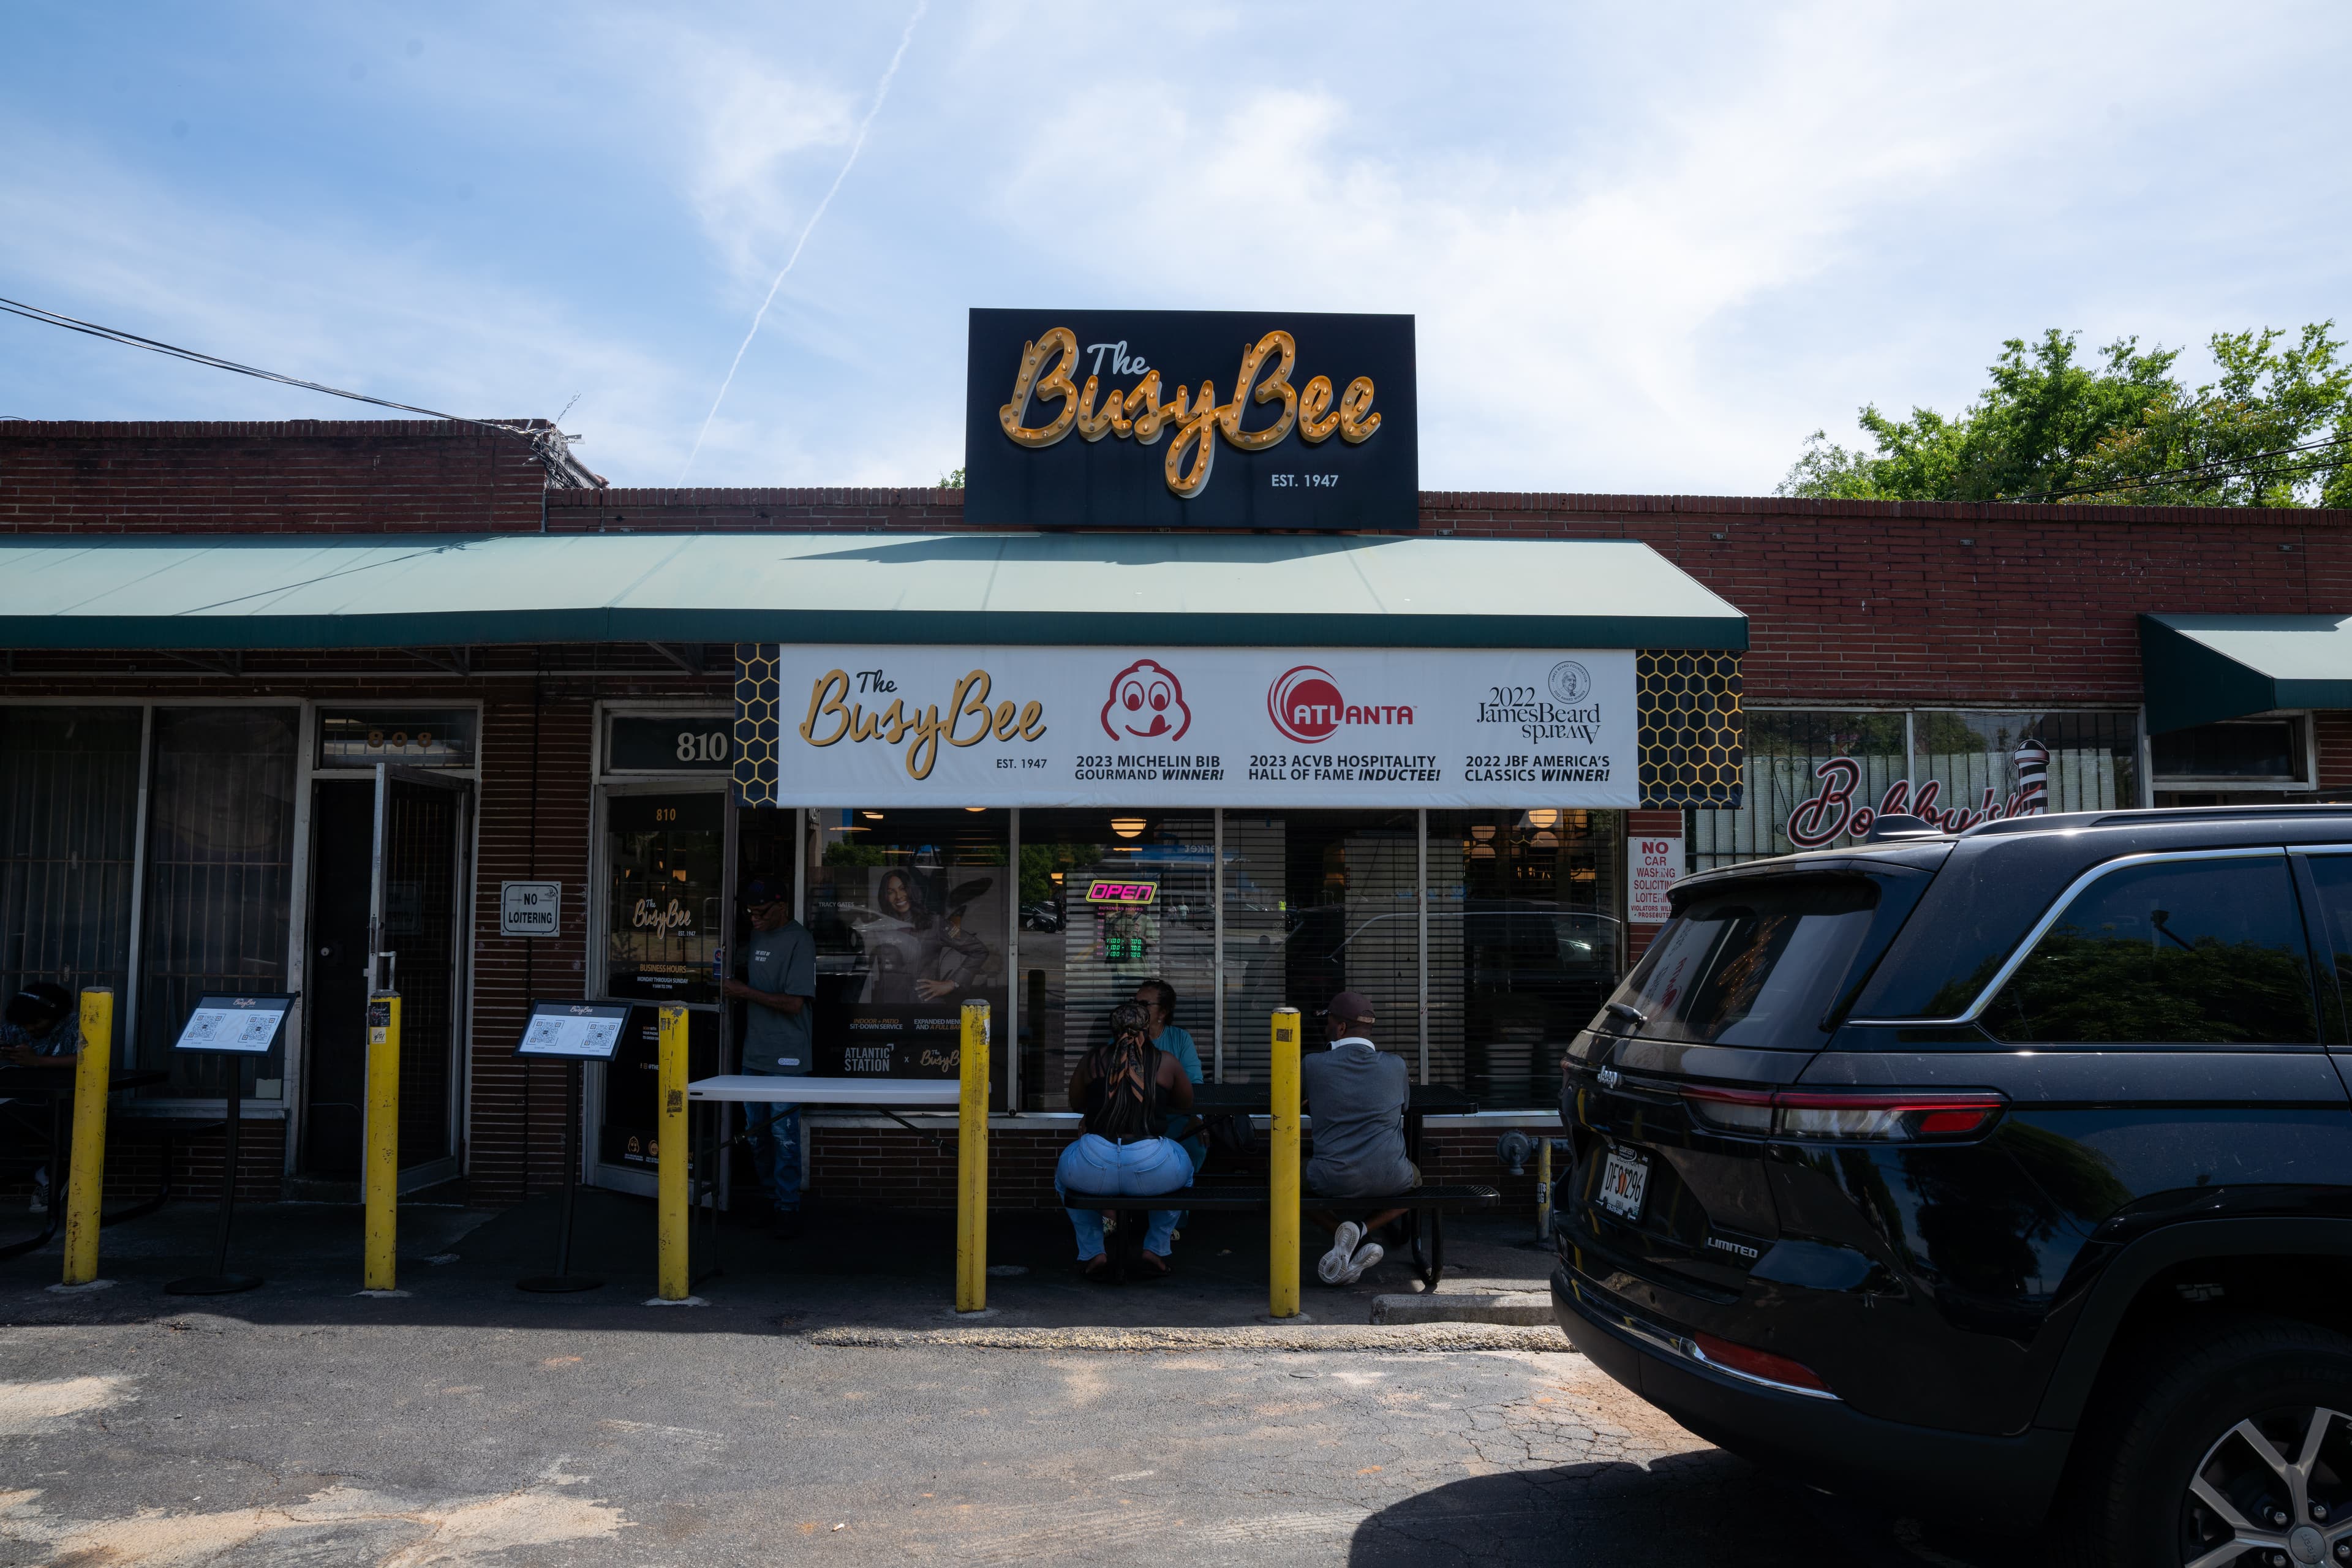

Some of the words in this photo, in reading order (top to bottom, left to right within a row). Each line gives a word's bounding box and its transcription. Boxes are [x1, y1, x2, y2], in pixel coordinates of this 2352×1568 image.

[1087, 341, 1150, 375] The
[999, 326, 1220, 499] Busy
[1219, 330, 1382, 450] Bee
[1272, 475, 1298, 487] EST.
[1304, 475, 1339, 487] 1947
[856, 669, 897, 693] The
[1488, 687, 1536, 707] 2022
[1294, 704, 1413, 725] ATLANTA
[799, 669, 940, 780] Busy
[940, 669, 1047, 748] Bee
[368, 730, 432, 748] 808
[1521, 724, 1601, 745] Awards
[676, 732, 728, 762] 810
[997, 758, 1017, 769] EST.
[1021, 758, 1047, 769] 1947
[1076, 755, 1112, 767] 2023
[1117, 755, 1191, 767] MICHELIN
[1196, 755, 1220, 767] BIB
[1250, 755, 1287, 767] 2023
[1292, 755, 1333, 767] ACVB
[1337, 755, 1436, 767] HOSPITALITY
[1466, 755, 1500, 767] 2022
[1504, 755, 1529, 767] JBF
[1533, 755, 1610, 767] AMERICA'S
[1074, 769, 1157, 780] GOURMAND
[1163, 769, 1224, 781] WINNER!
[1248, 769, 1286, 780] HALL
[1291, 769, 1310, 780] OF
[1314, 769, 1354, 781] FAME
[1358, 769, 1441, 782] INDUCTEE!
[1464, 769, 1536, 782] CLASSICS
[1541, 769, 1610, 782] WINNER!
[656, 808, 676, 821] 810
[1642, 842, 1669, 854] NO
[1645, 856, 1667, 865] CAR
[1634, 880, 1674, 890] SOLICITIN
[1090, 884, 1153, 900] OPEN
[1635, 892, 1671, 903] LOITERIN
[524, 893, 537, 905] NO
[646, 898, 656, 908] The
[508, 911, 552, 924] LOITERING
[633, 898, 666, 940] Busy
[666, 899, 692, 928] Bee
[639, 963, 666, 973] BUSINESS
[666, 965, 687, 973] HOURS
[845, 1047, 891, 1059] ATLANTIC
[844, 1058, 890, 1072] STATION
[920, 1049, 949, 1072] Busy
[1597, 1065, 1618, 1090] Jeep
[1707, 1237, 1759, 1259] LIMITED
